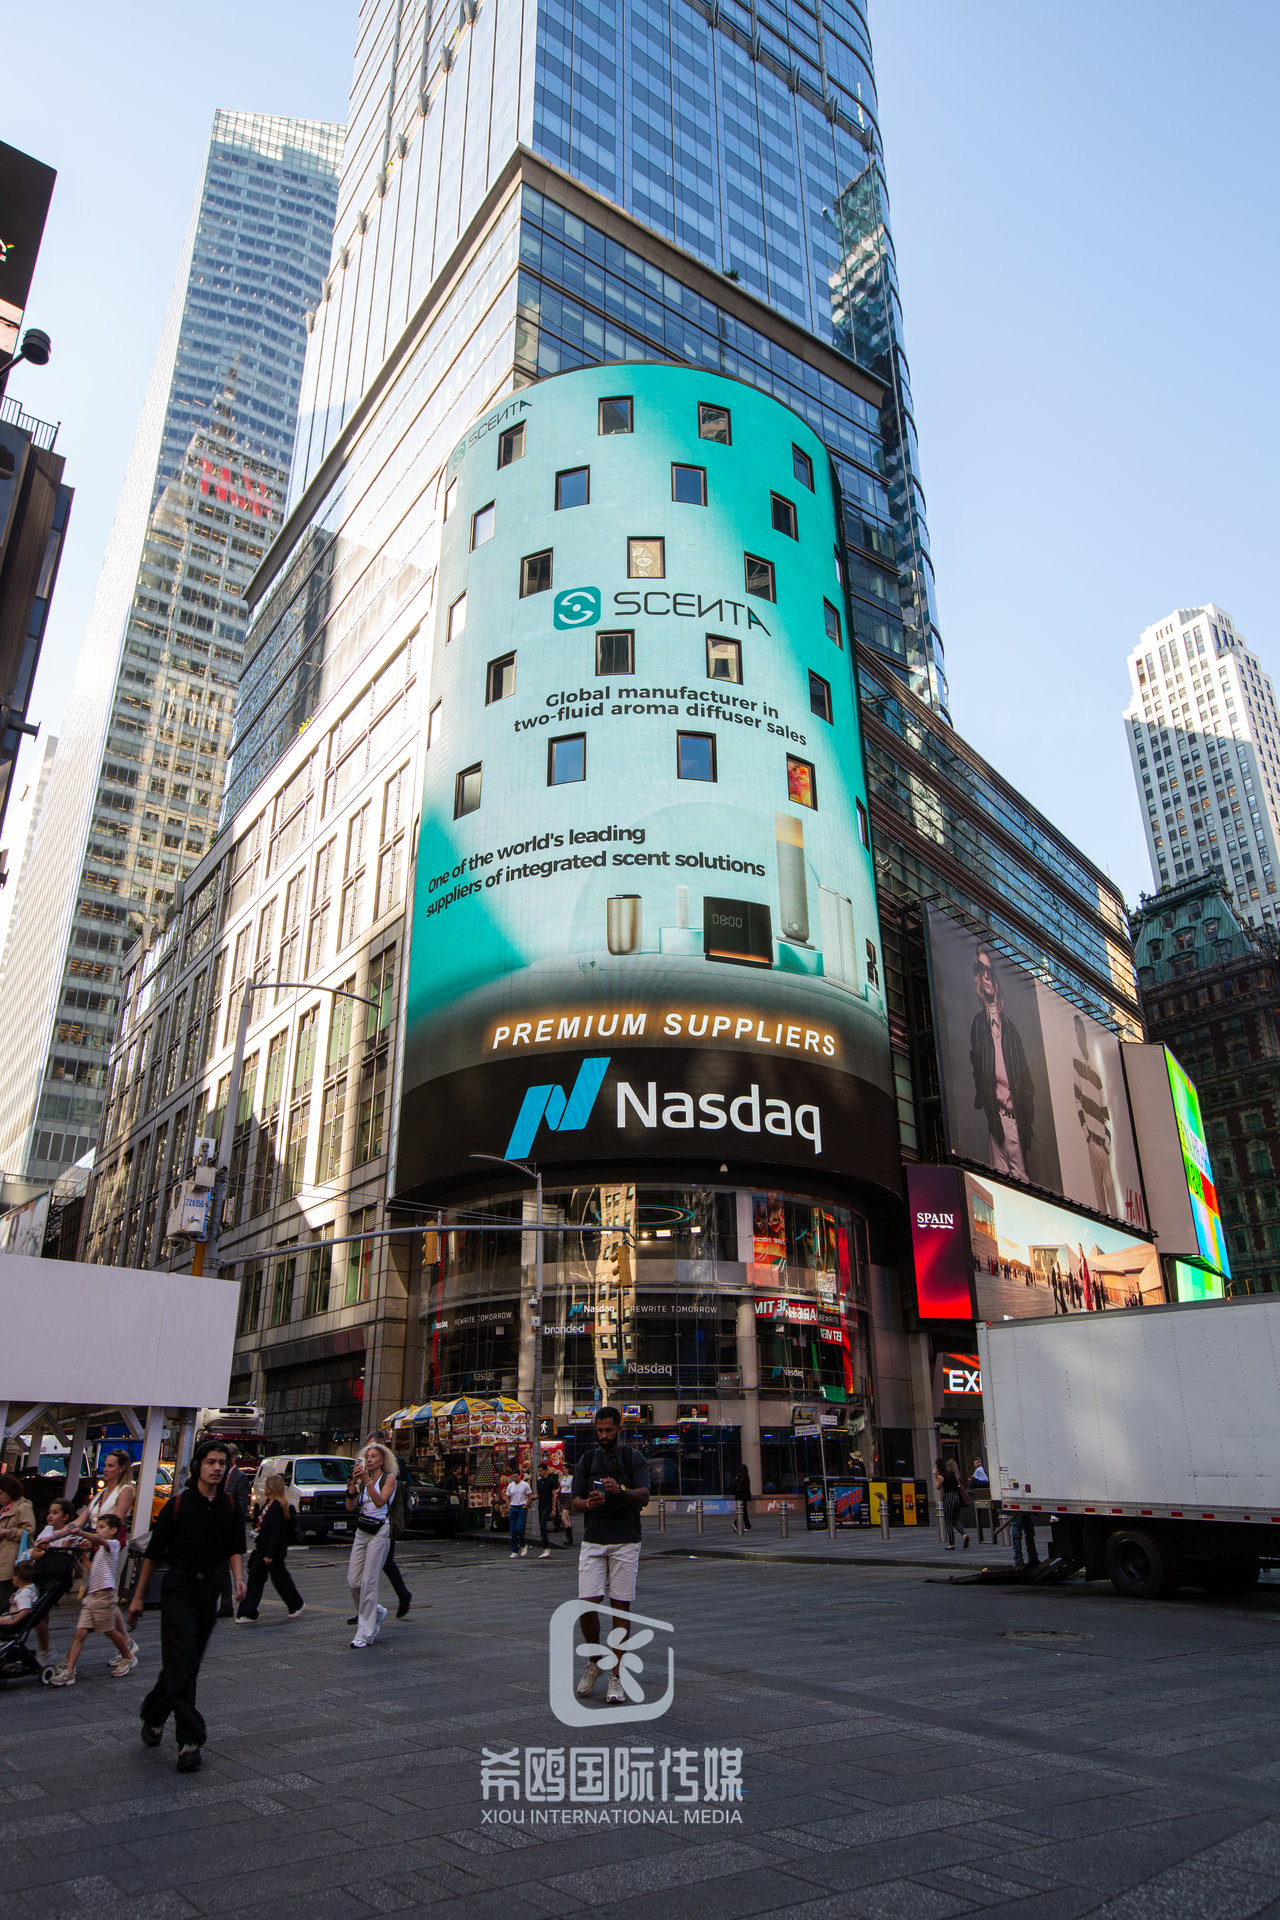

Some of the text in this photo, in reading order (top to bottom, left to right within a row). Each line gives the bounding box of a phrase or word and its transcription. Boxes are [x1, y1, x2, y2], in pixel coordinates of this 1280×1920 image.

[613, 591, 772, 637] SCENTA
[545, 685, 779, 719] Global manufacturer in
[513, 702, 807, 746] two-fluid aroma diffuser sales
[428, 825, 646, 894] One of the world's leading
[426, 850, 766, 918] suppliers of integrated scent solutions
[712, 913, 743, 929] 08:00
[492, 1013, 836, 1057] PREMIUM SUPPLIERS
[616, 1081, 822, 1155] Nasdaq
[916, 1212, 954, 1225] SPAIN
[1125, 1187, 1145, 1229] H&M
[477, 1311, 513, 1322] TOMORROW
[583, 1304, 615, 1314] Nasdaq
[630, 1305, 718, 1314] REWRITE TOMORROW
[628, 1362, 673, 1376] Nasdaq
[948, 1369, 983, 1393] EX
